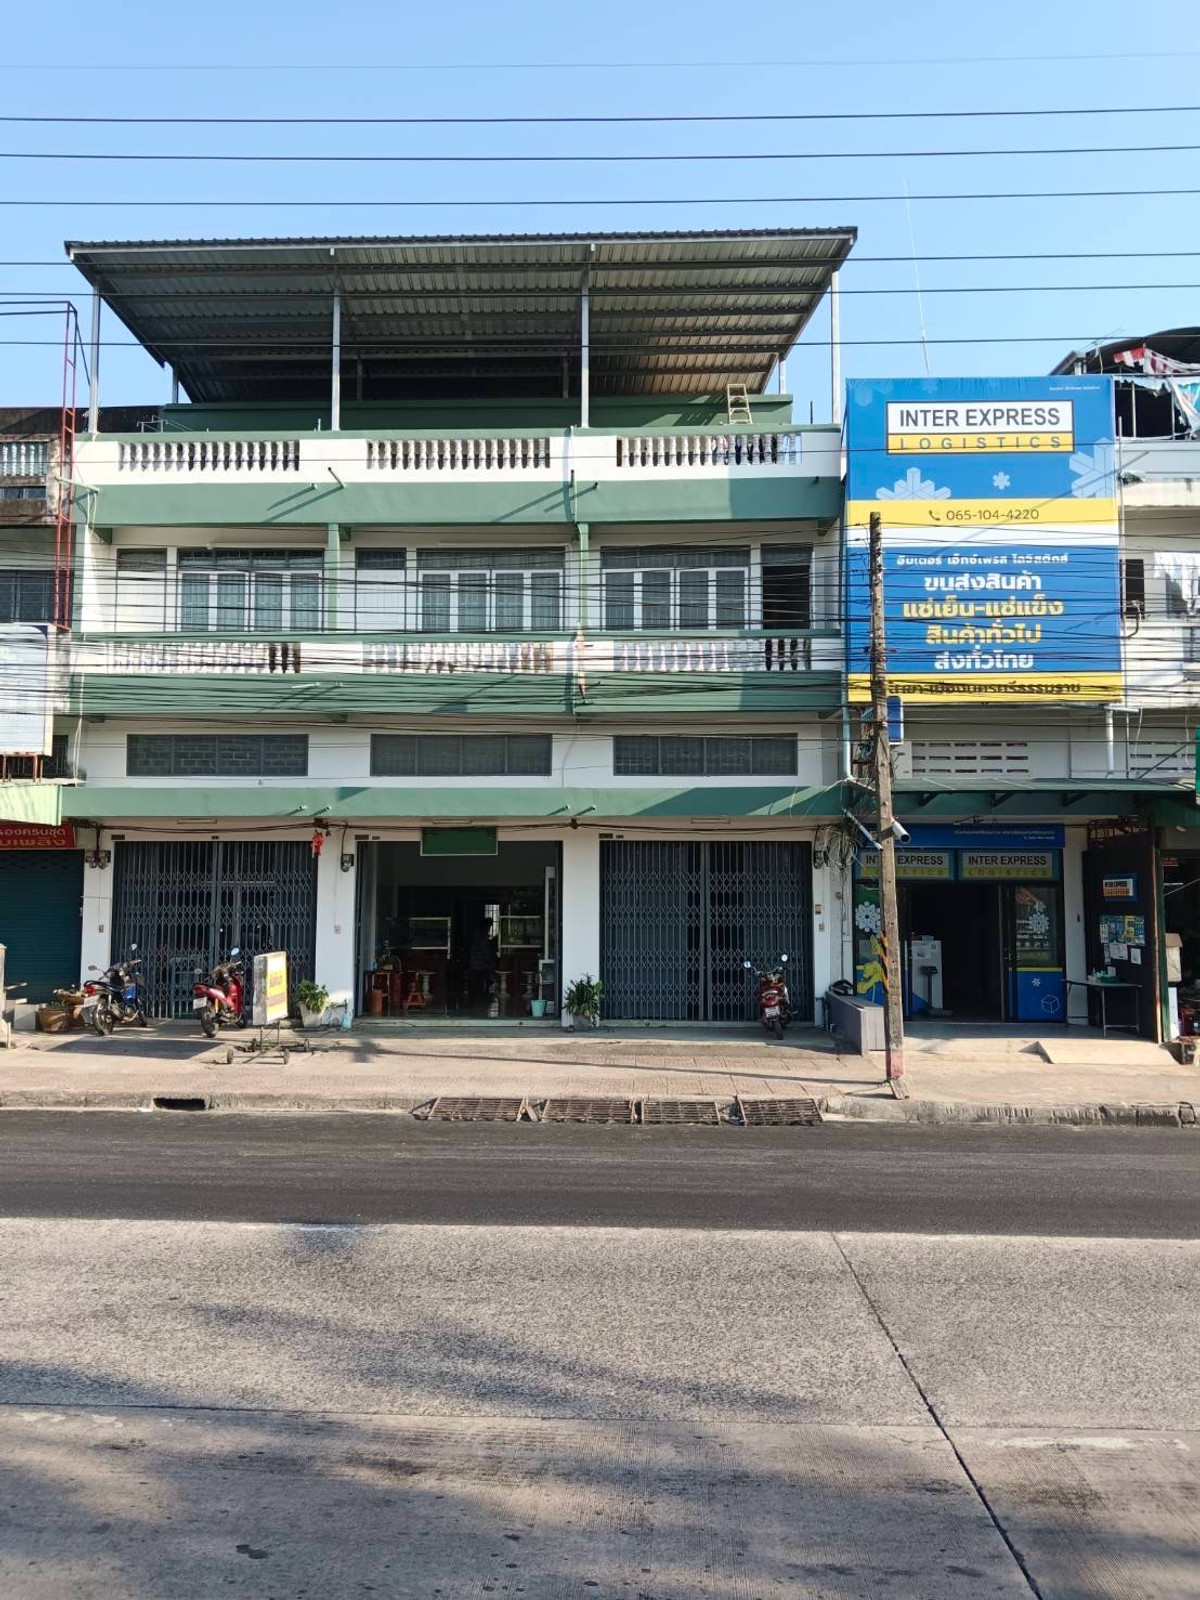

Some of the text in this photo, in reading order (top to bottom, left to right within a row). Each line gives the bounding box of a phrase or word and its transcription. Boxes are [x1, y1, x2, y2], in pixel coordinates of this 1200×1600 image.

[900, 407, 1060, 427] INTER EXPRESS
[900, 436, 1061, 450] LOGISTICS
[946, 508, 1039, 521] 065-104-4220
[924, 570, 1042, 591] ขนส่งสินค้า
[903, 593, 1064, 618] แช่เย็น-แช่แข็ง
[925, 617, 1042, 645] สินค้าทั่วไป
[934, 644, 1034, 670] ส่งทั่วไทย
[897, 855, 944, 865] EXPRESS
[968, 855, 1047, 865] INTER EXPRESS
